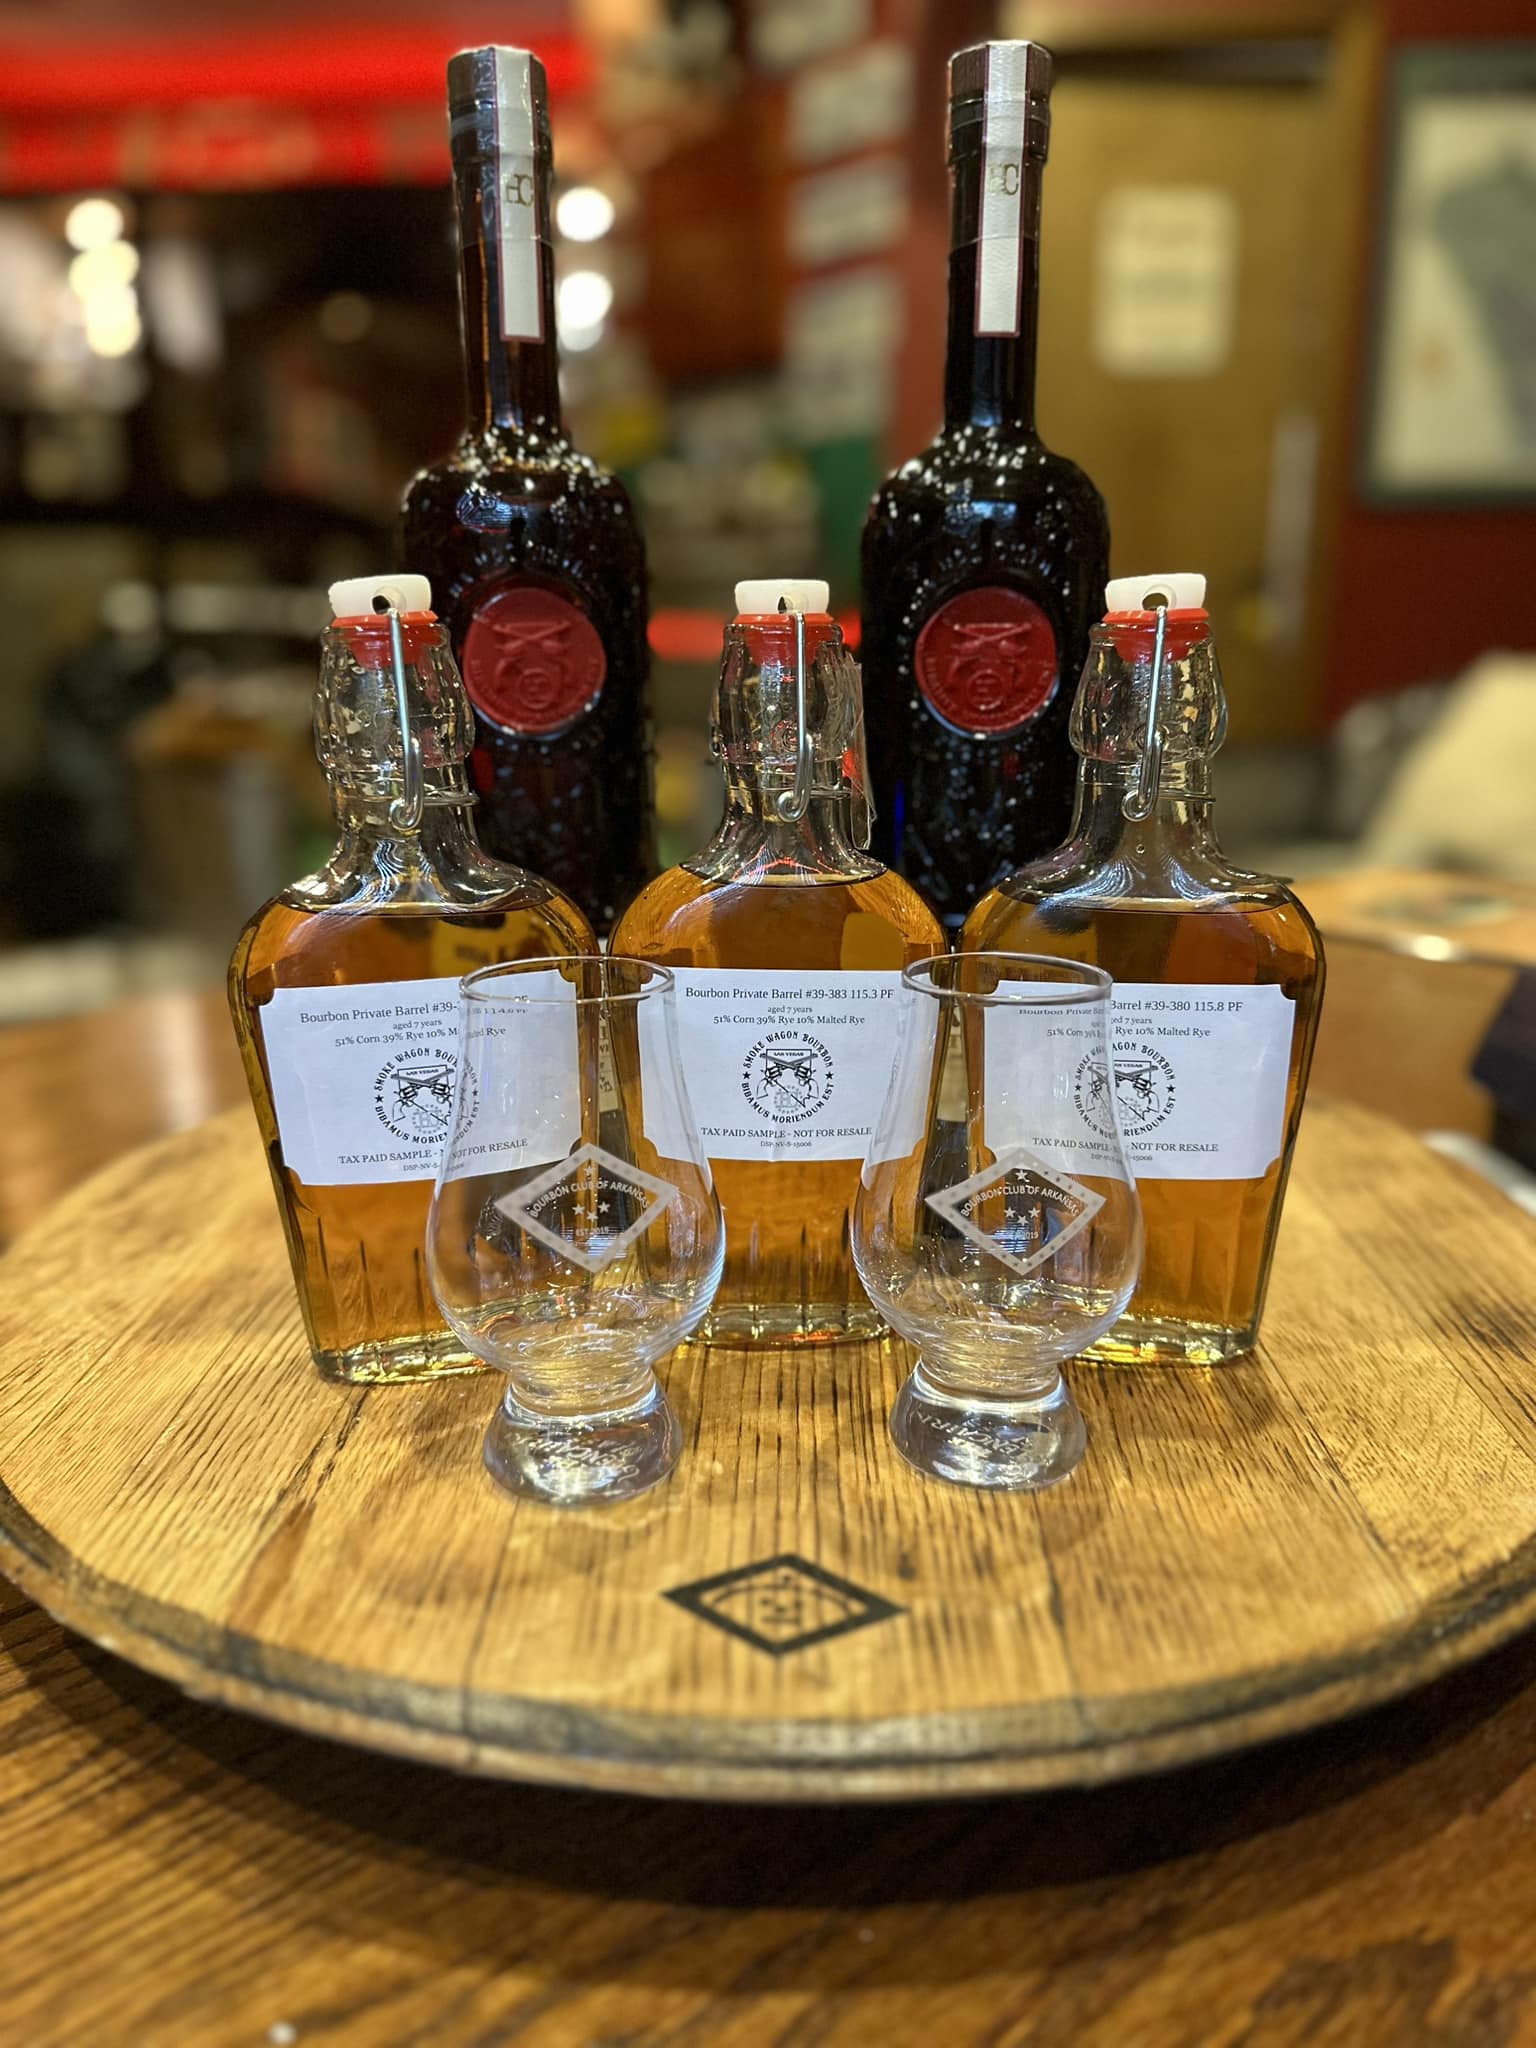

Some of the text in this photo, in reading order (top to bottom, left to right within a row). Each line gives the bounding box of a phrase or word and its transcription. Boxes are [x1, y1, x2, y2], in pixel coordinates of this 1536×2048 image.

[686, 987, 894, 999] Bourbon Private Barrel #39-383 115.3 PF
[300, 1011, 349, 1023] Bourbon
[352, 1008, 392, 1020] Private
[395, 1004, 429, 1016] Barrel
[767, 1006, 785, 1014] aged
[792, 1006, 813, 1014] years
[1104, 1000, 1141, 1012] Barrel
[1144, 1001, 1191, 1011] #39-380
[1194, 1001, 1224, 1012] 115.8
[1228, 1001, 1243, 1011] PF
[392, 1019, 442, 1030] aged 7 years
[713, 1015, 865, 1025] 51% Corn 39% Rye 10% Malted Rye
[1131, 1017, 1153, 1025] years
[335, 1037, 354, 1047] 51%
[356, 1035, 380, 1045] Corn
[382, 1032, 403, 1044] 39%
[406, 1030, 424, 1042] Rye
[426, 1028, 446, 1038] 10%
[486, 1027, 506, 1037] Rye
[1047, 1028, 1064, 1037] 51%
[1066, 1028, 1083, 1036] Corn
[1116, 1026, 1133, 1036] Rye
[1135, 1027, 1155, 1036] 10%
[1157, 1027, 1190, 1036] Malted
[1192, 1027, 1211, 1038] Rye
[742, 1030, 834, 1068] SMOKE WAGON BOURBON
[374, 1062, 396, 1091] SMOKE
[394, 1047, 430, 1063] WAGON
[1141, 1044, 1176, 1081] BOURBON
[741, 1082, 834, 1124] BIBAMUS MORIENDUM EST
[1162, 1096, 1176, 1114] EST
[375, 1105, 410, 1140] BIBAMUS
[701, 1127, 723, 1136] TAX
[722, 1128, 746, 1138] PAID
[746, 1129, 786, 1138] SAMPLE
[793, 1129, 814, 1138] NOT
[816, 1128, 835, 1138] FOR
[836, 1127, 872, 1137] RESALE
[338, 1154, 360, 1164] TAX
[362, 1153, 388, 1164] PAID
[389, 1150, 432, 1162] SAMPLE
[468, 1143, 487, 1156] FOR
[488, 1138, 528, 1153] RESALE
[1032, 1138, 1052, 1147] TAX
[1053, 1139, 1078, 1148] PAID
[1131, 1142, 1154, 1152] NOT
[1155, 1143, 1176, 1152] FOR
[1178, 1143, 1219, 1152] RESALE
[530, 1180, 650, 1218] BOURBON CLUB OF ARKANSAS
[960, 1184, 1080, 1217] BOURBON CLUB OF ARKANSAS
